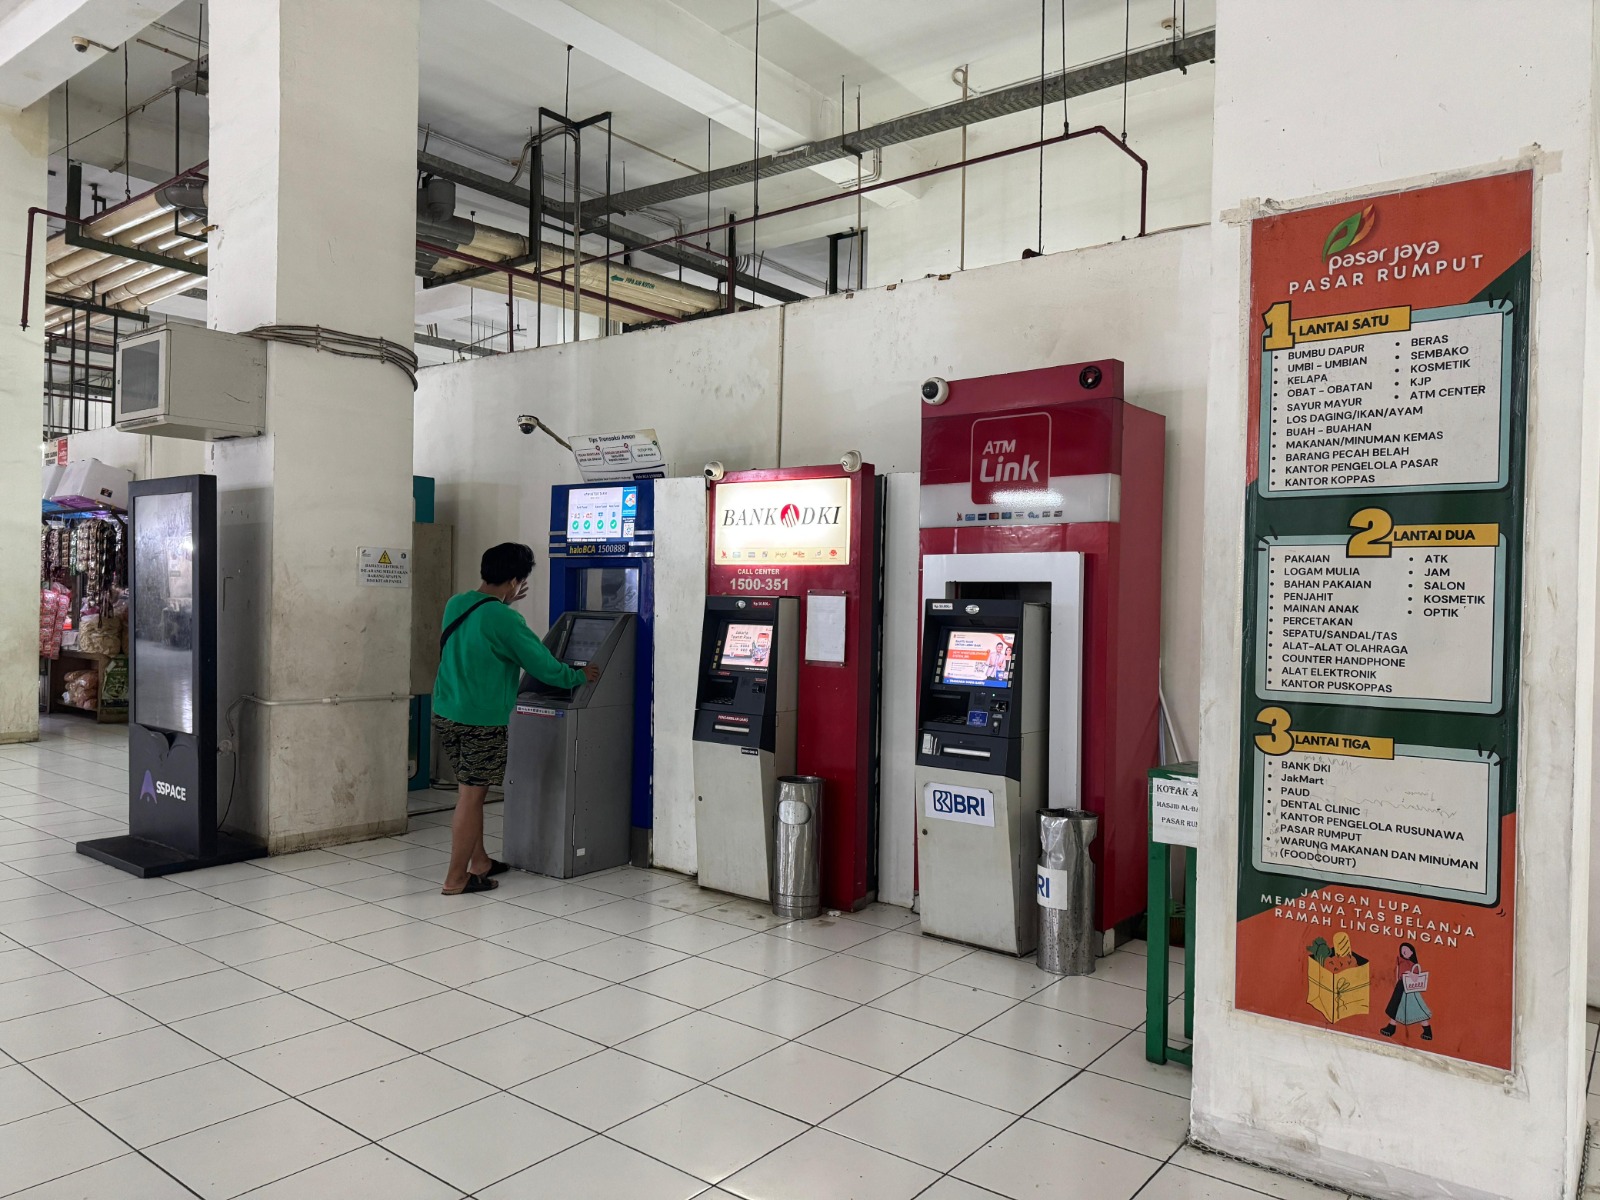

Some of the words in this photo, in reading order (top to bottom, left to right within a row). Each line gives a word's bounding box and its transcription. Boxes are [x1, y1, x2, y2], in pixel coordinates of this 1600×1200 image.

[1329, 248, 1387, 275] pasar
[1390, 240, 1440, 266] jaya
[1289, 272, 1364, 294] PASAR
[1377, 255, 1483, 282] RUMPUT
[1262, 301, 1295, 351] 1
[1299, 320, 1348, 336] LANTAI
[1352, 314, 1389, 329] SATU
[1411, 334, 1449, 347] BERAS
[1288, 348, 1326, 360] BUMBU
[1328, 344, 1365, 356] DAPUR
[1410, 346, 1469, 360] SEMBAKO
[1288, 361, 1314, 372] UMBI
[1325, 356, 1368, 370] UMBIAN
[1410, 359, 1470, 373] KOSMETIK
[1287, 374, 1328, 385] KELAPA
[1410, 377, 1432, 387] KJP
[1287, 387, 1316, 398] OBAT
[1327, 382, 1372, 394] OBATAN
[1410, 389, 1436, 400] ATM
[1438, 385, 1486, 397] CENTER
[1287, 401, 1321, 411] SAYUR
[1324, 397, 1362, 408] MAYUR
[1286, 414, 1308, 424] LOS
[1310, 406, 1423, 423] DAGING/IKAN/AYAM
[1286, 426, 1315, 437] BUAH
[1326, 423, 1372, 435] BUAHAN
[982, 439, 1016, 455] ATM
[1286, 435, 1401, 450] MAKANAN/MINUMAN
[1403, 431, 1444, 442] KEMAS
[1285, 451, 1330, 462] BARANG
[1332, 448, 1370, 459] PECAH
[1372, 447, 1409, 457] BELAH
[979, 454, 1040, 483] Link
[1285, 464, 1328, 475] KANTOR
[1331, 460, 1397, 472] PENGELOLA
[1400, 458, 1438, 469] PASAR
[1285, 478, 1328, 487] KANTOR
[1331, 474, 1375, 485] KOPPAS
[722, 508, 778, 527] BANK
[802, 506, 842, 526] DKI
[1346, 507, 1394, 558] 2
[1393, 530, 1442, 542] LANTAI
[1445, 530, 1476, 541] DUA
[569, 544, 596, 554] haloBCA
[598, 544, 626, 552] 1500888
[1284, 555, 1330, 563] PAKAIAN
[1424, 554, 1448, 564] ATK
[1284, 568, 1323, 576] LOGAM
[1325, 567, 1360, 576] MULIA
[1424, 568, 1450, 577] JAM
[730, 578, 789, 591] 1500-351
[1284, 580, 1320, 589] BAHAN
[1322, 580, 1372, 589] PAKAIAN
[1424, 581, 1465, 591] SALON
[1283, 592, 1333, 601] PENJAHIT
[1423, 594, 1485, 605] KOSMETIK
[1283, 604, 1325, 614] MAINAN
[1328, 605, 1359, 614] ANAK
[1423, 608, 1459, 618] OPTIK
[1283, 617, 1353, 626] PERCETAKAN
[1282, 629, 1398, 641] SEPATU/SANDAL/TAS
[1345, 644, 1408, 654] OLAHRAGA
[1282, 654, 1332, 664] COUNTER
[1335, 656, 1406, 668] HANDPHONE
[1282, 666, 1308, 676] ALAT
[1310, 668, 1377, 679] ELEKTRONIK
[1281, 679, 1325, 689] KANTOR
[1327, 682, 1392, 693] PUSKOPPAS
[1253, 706, 1294, 756] 3
[1295, 735, 1340, 747] LANTAI
[1342, 738, 1371, 750] TIGA
[1281, 760, 1310, 771] BANK
[1313, 763, 1331, 772] DKI
[1281, 774, 1324, 785] JakMart
[156, 781, 186, 801] SSPACE
[1156, 784, 1188, 796] KOTAK
[1281, 787, 1310, 797] PAUD
[954, 794, 985, 817] BRI
[1280, 800, 1322, 811] DENTAL
[1325, 805, 1361, 816] CLINIC
[1161, 817, 1184, 825] PASAR
[1280, 812, 1324, 824] KANTOR
[1327, 817, 1392, 832] PENGELOLA
[1395, 825, 1465, 841] RUSUNAWA
[1280, 824, 1315, 836] PASAR
[1317, 828, 1362, 841] RUMPUT
[1280, 836, 1328, 850] WARUNG
[1330, 843, 1388, 858] MAKANAN
[1391, 850, 1416, 862] DAN
[1419, 854, 1478, 870] MINUMAN
[1280, 849, 1356, 869] (FOODCOURT)
[1301, 888, 1370, 906] JANGAN
[1379, 900, 1422, 915] LUPA
[1261, 894, 1345, 916] MEMBAWA
[1354, 908, 1385, 922] TAS
[1394, 915, 1475, 937] BELANJA
[1275, 909, 1331, 927] RAMAH
[1341, 920, 1458, 948] LINGKUNGAN
